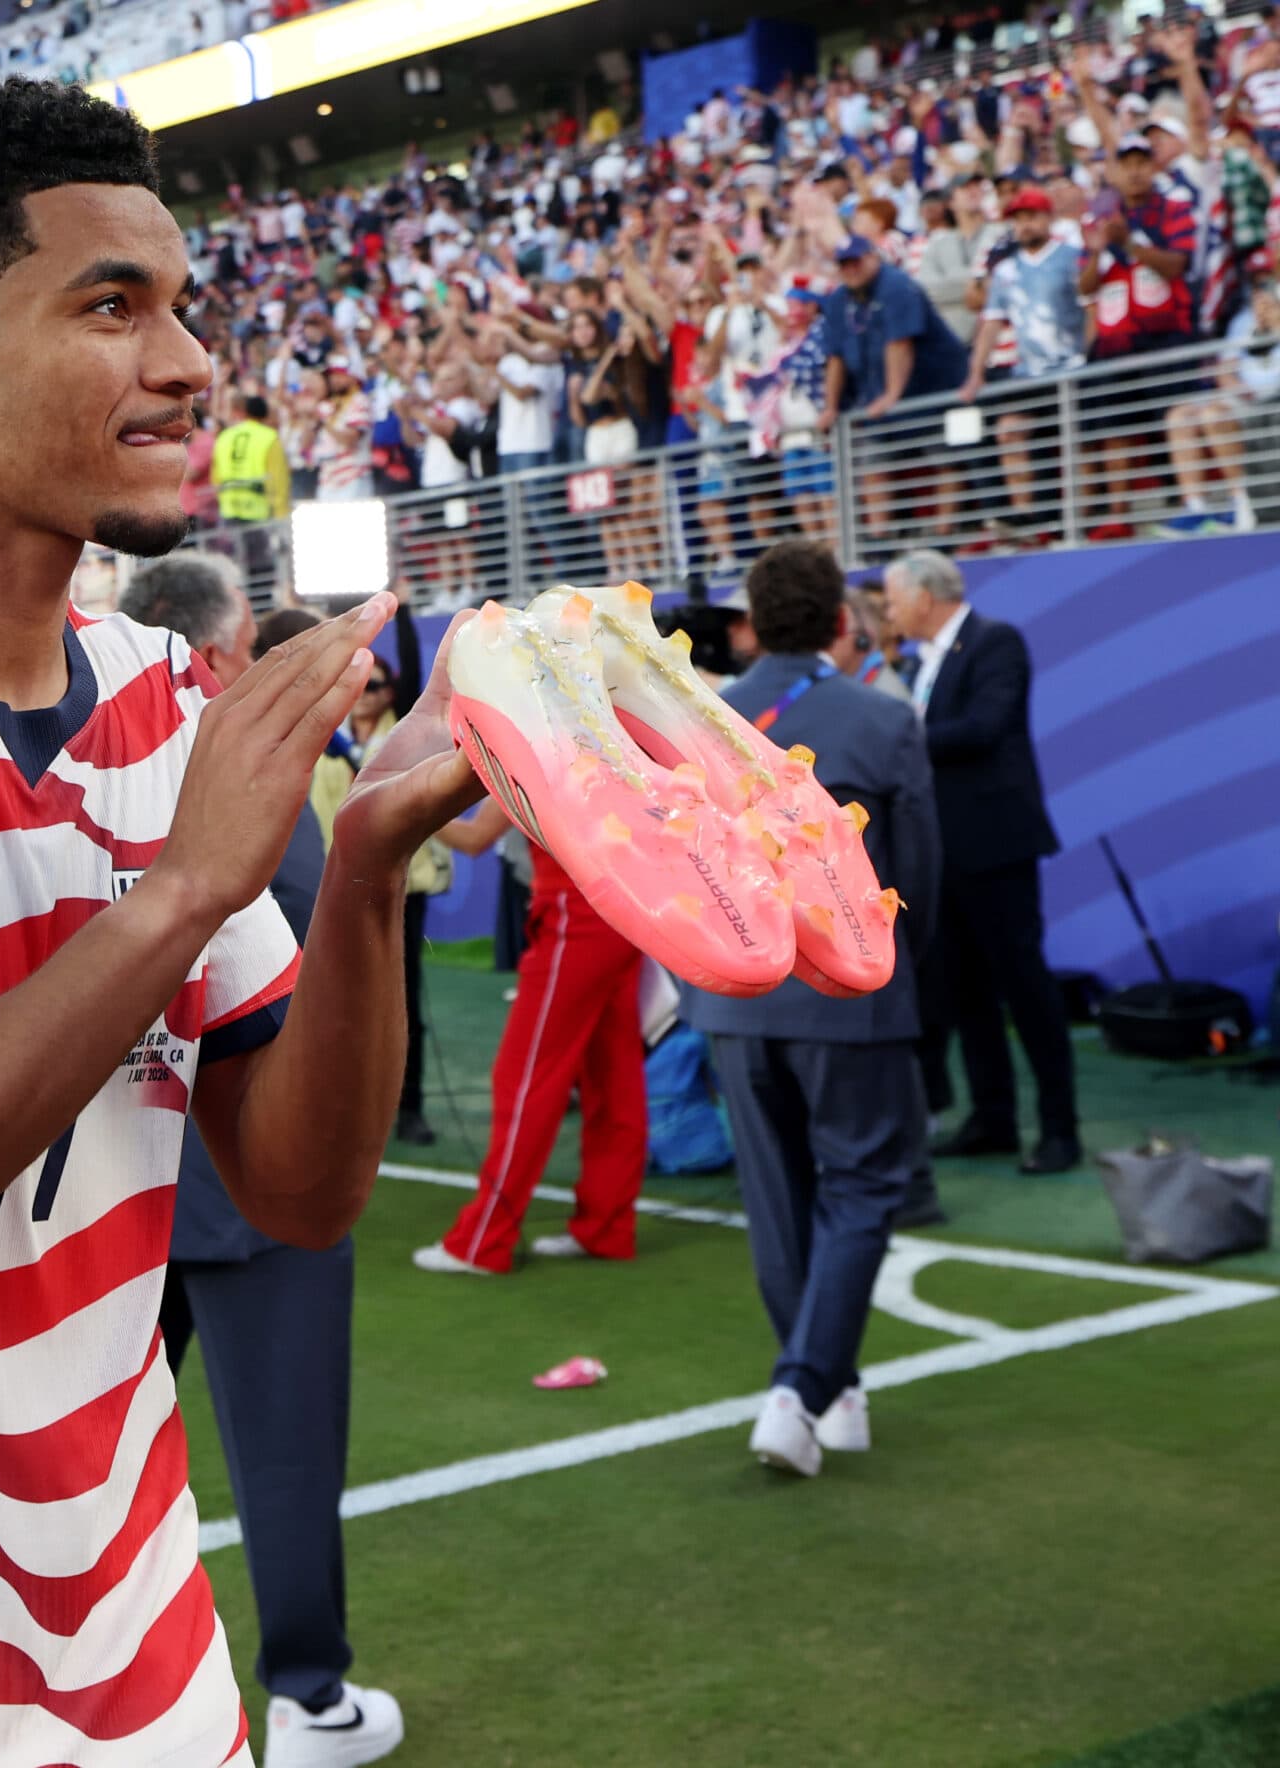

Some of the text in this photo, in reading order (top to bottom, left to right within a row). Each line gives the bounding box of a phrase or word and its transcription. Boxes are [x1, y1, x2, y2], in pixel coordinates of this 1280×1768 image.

[687, 851, 757, 949] PREDATOR
[157, 1032, 168, 1045] BIH
[170, 1049, 184, 1063] CA
[148, 1068, 168, 1081] 2026
